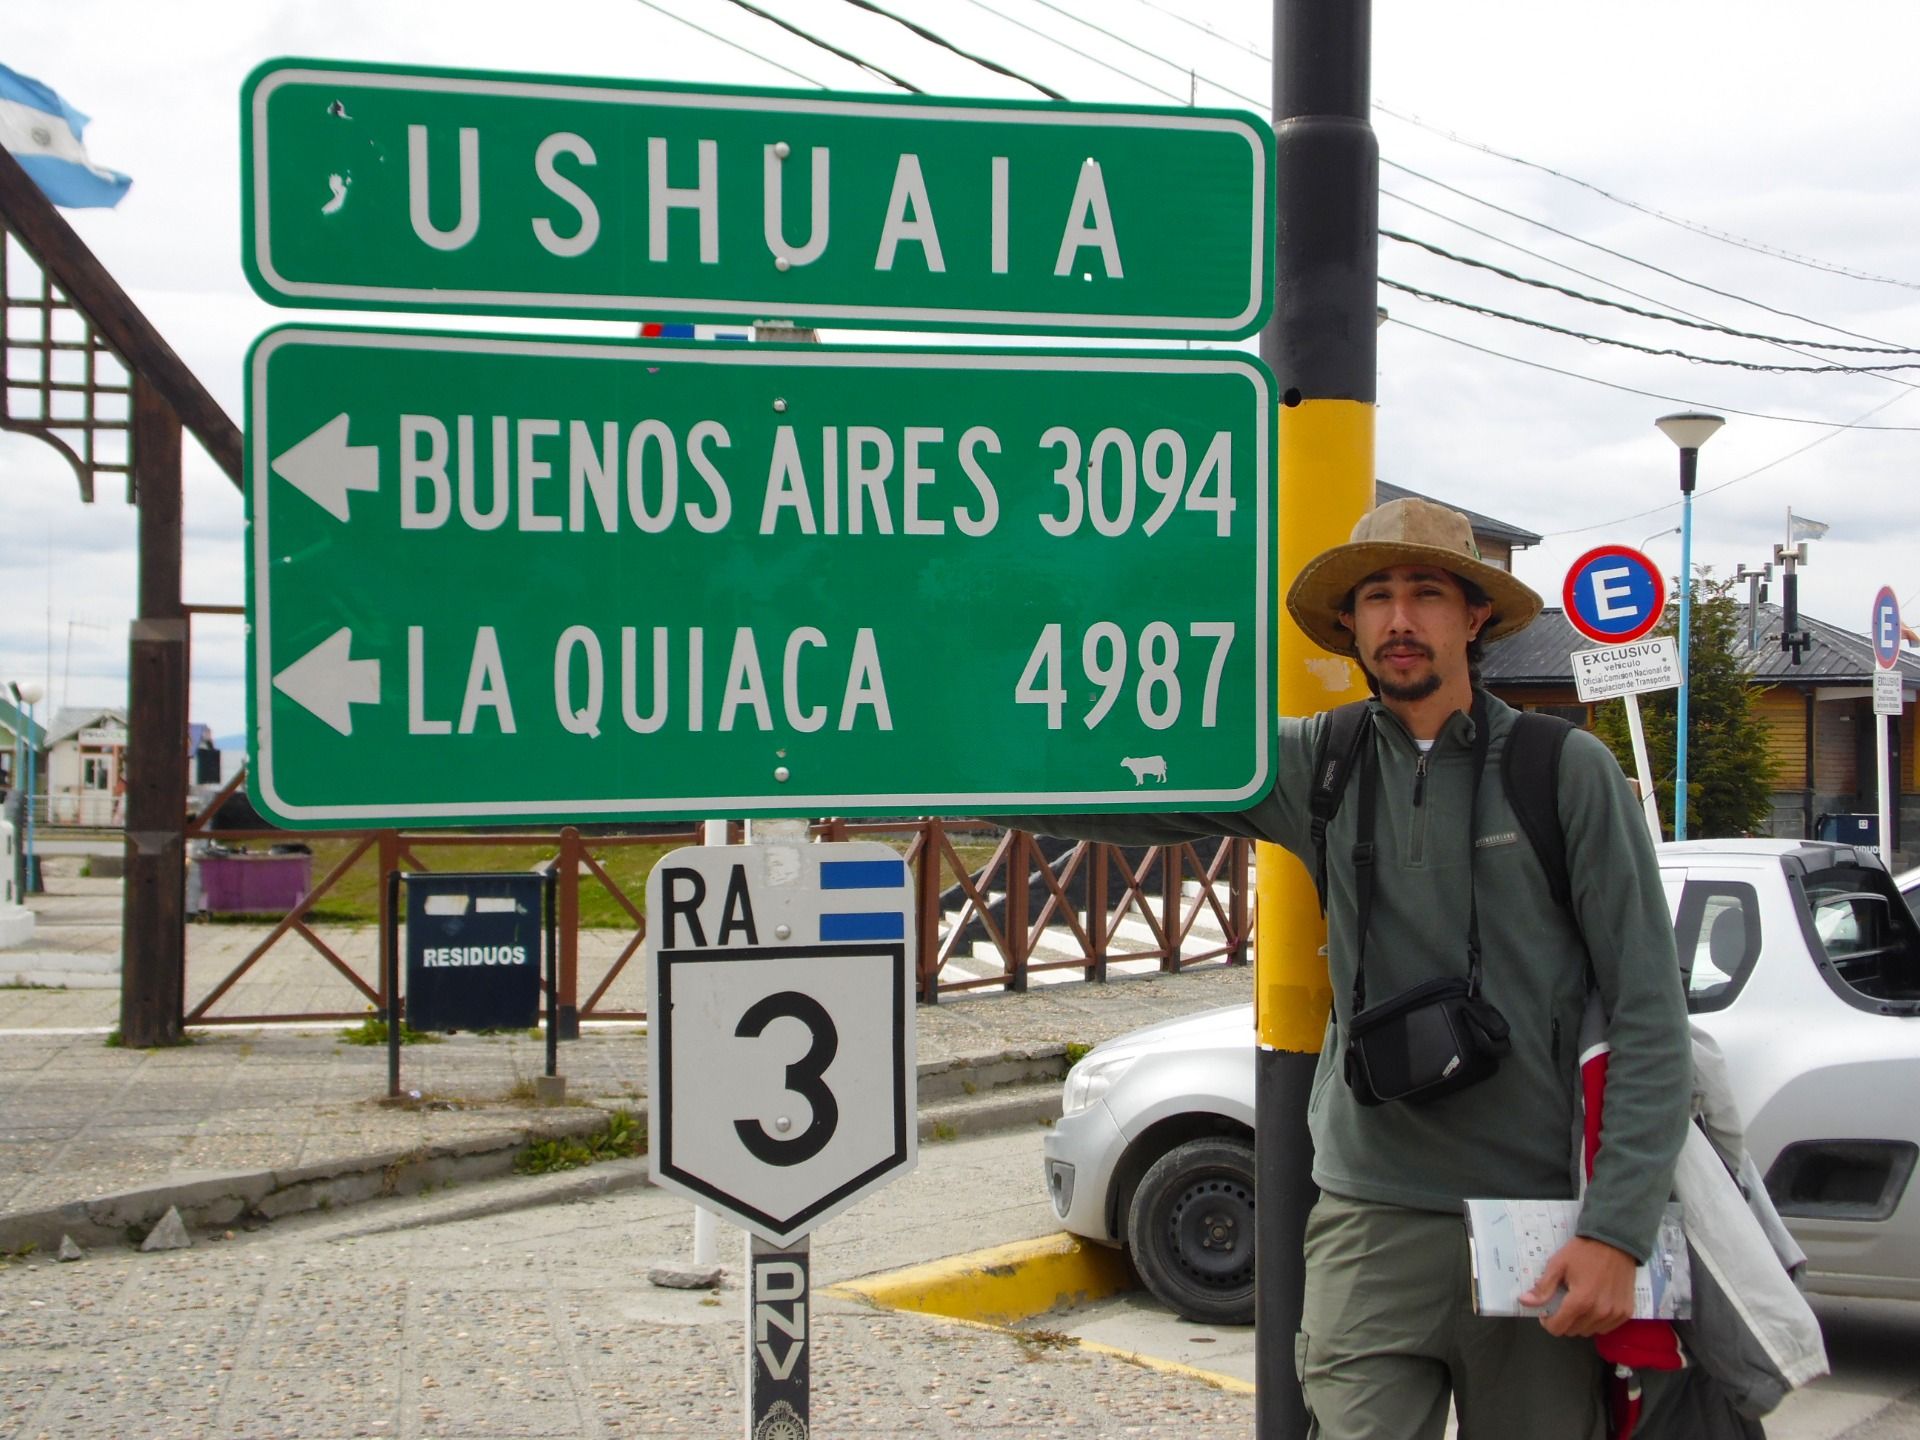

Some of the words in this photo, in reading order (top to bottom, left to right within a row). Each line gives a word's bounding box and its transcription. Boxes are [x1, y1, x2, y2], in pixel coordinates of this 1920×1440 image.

[408, 124, 1124, 280] USHUAIA
[401, 414, 732, 534] BUENOS
[760, 425, 1002, 537] AIRES
[1038, 427, 1237, 538] 3094
[1591, 567, 1638, 620] E
[1880, 606, 1893, 648] E
[408, 626, 517, 735] LA
[555, 625, 894, 739] QUIACA
[1015, 621, 1236, 730] 4987
[1582, 643, 1661, 666] EXCLUSIVO
[1626, 680, 1634, 688] de
[1635, 675, 1671, 686] Transporte
[1634, 666, 1662, 677] Nacional
[661, 864, 759, 948] RA
[423, 946, 526, 967] RESIDUOS
[734, 990, 839, 1167] 3
[755, 1261, 805, 1381] DNV
